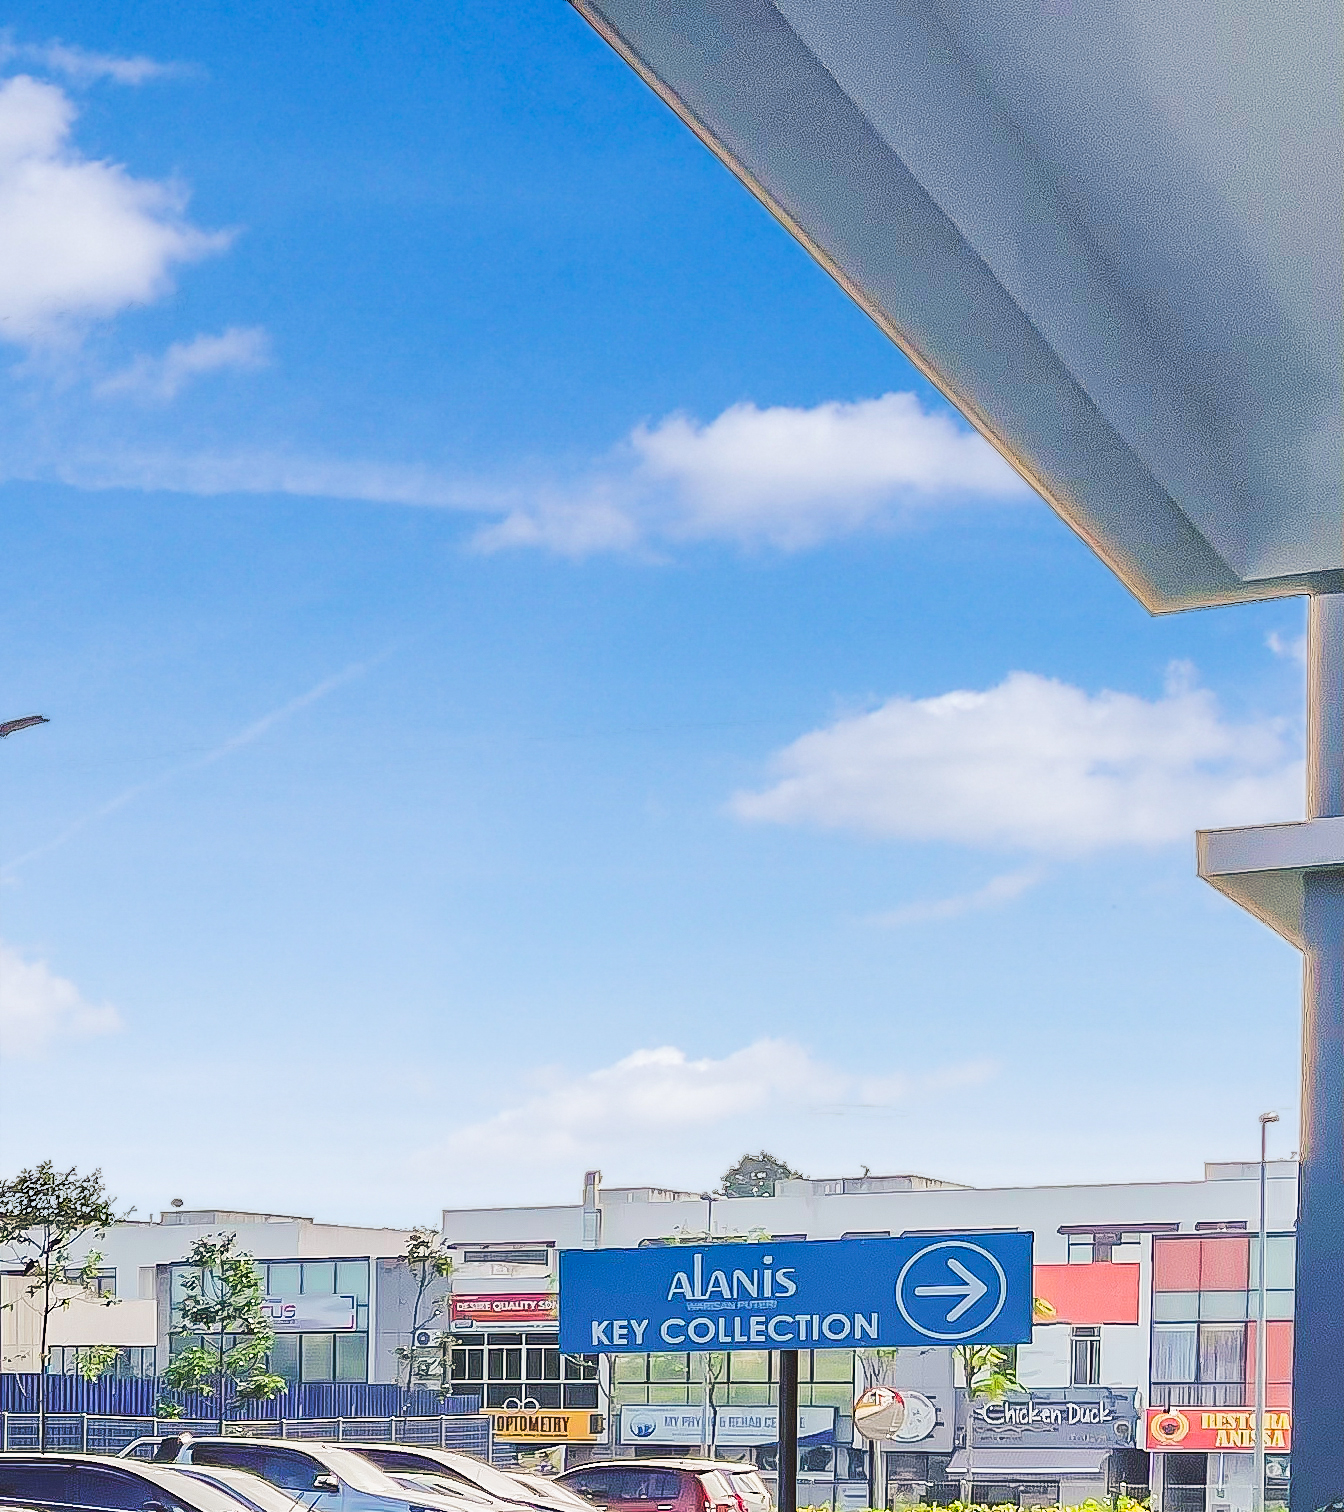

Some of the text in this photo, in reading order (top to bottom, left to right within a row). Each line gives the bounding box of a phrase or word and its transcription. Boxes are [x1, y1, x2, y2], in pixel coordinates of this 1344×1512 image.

[493, 1300, 537, 1312] QUALITY
[591, 1312, 878, 1346] KEY COLLECTION
[984, 1400, 1113, 1425] Chicken Duck
[497, 1416, 570, 1433] OPTOMETRY
